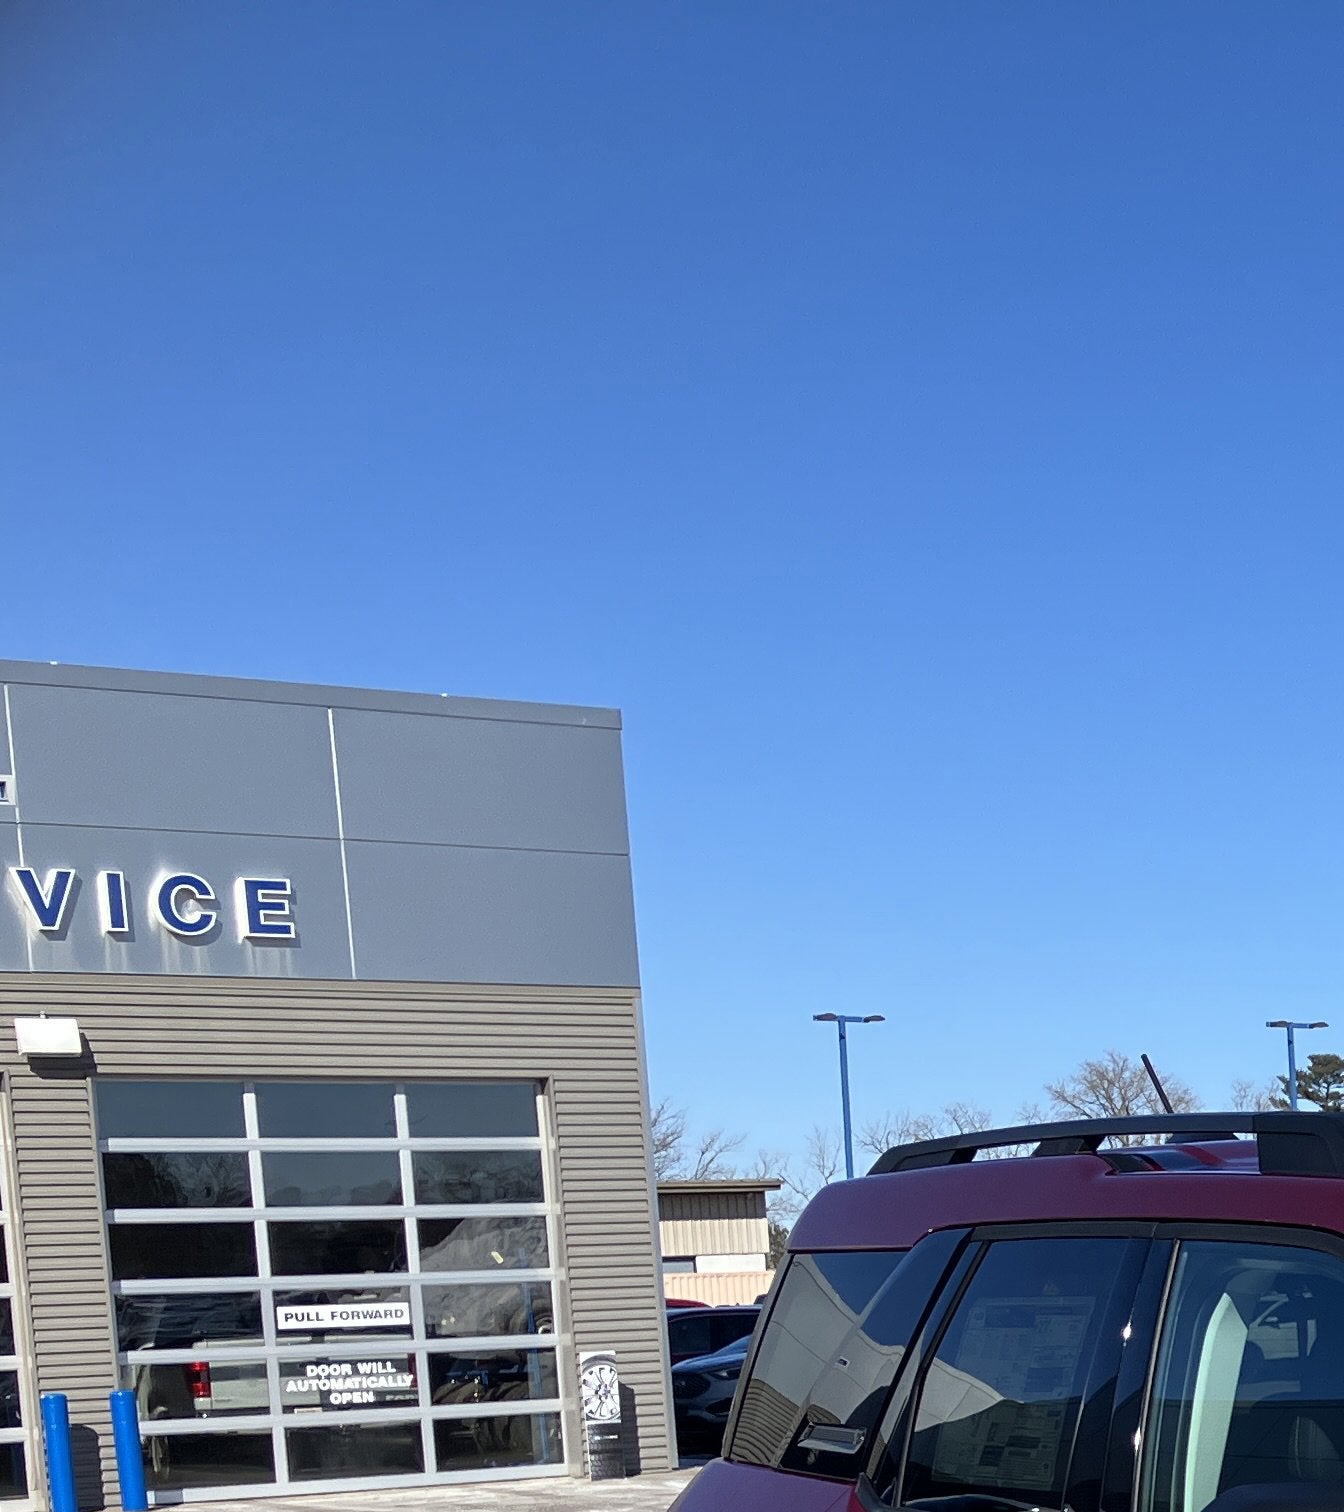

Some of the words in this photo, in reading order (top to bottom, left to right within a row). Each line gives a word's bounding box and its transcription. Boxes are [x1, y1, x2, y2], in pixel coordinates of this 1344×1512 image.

[284, 1312, 325, 1322] PULL
[330, 1309, 405, 1321] FORWARD
[306, 1363, 353, 1377] DOOR
[357, 1361, 397, 1374] WILL
[286, 1374, 414, 1393] AUTOMATICALLY
[329, 1391, 376, 1405] OPEN
